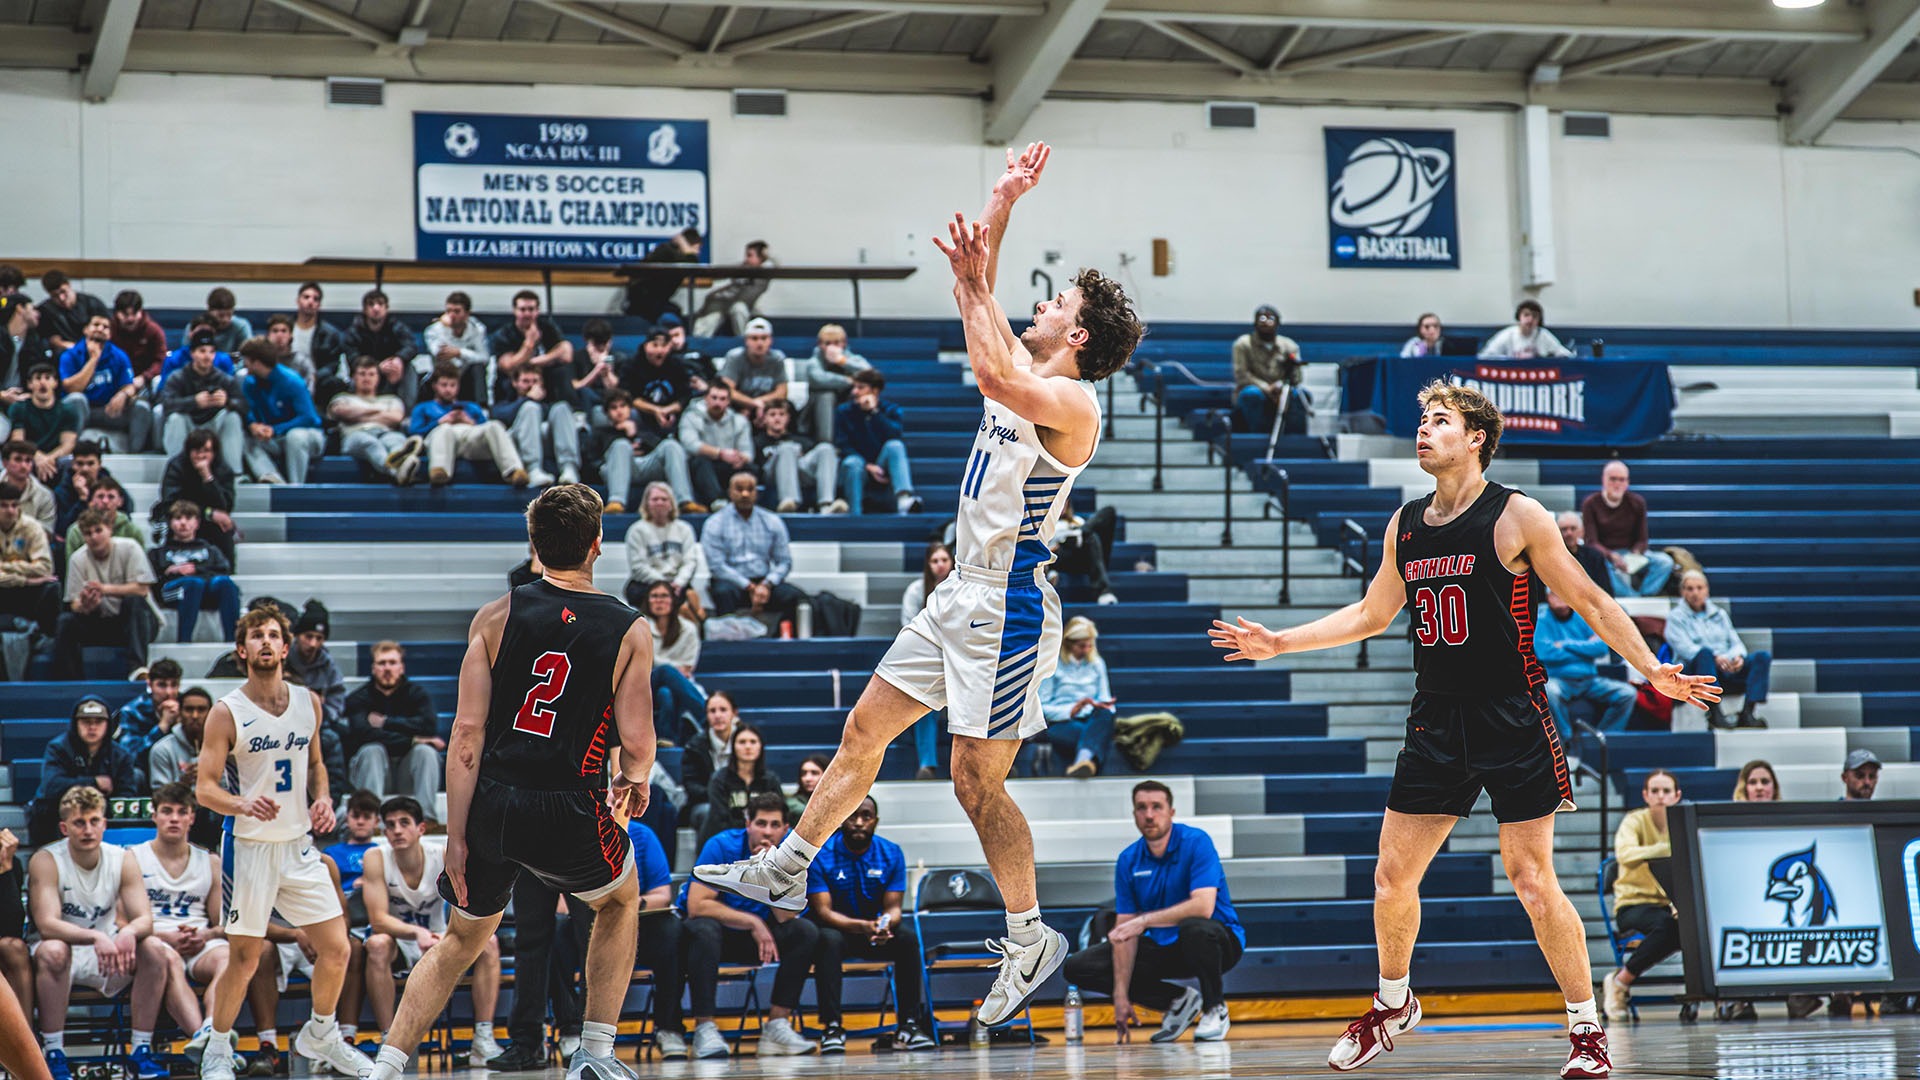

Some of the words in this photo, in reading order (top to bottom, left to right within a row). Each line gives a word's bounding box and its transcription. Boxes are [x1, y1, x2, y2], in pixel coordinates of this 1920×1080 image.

[539, 123, 588, 143] 1989
[505, 144, 556, 160] NCAA
[560, 145, 595, 161] DIV.
[599, 145, 621, 161] III
[484, 174, 549, 192] MEN'S
[556, 175, 645, 194] SOCCER
[426, 197, 552, 225] NATIONAL
[560, 199, 699, 227] CHAMPIONS
[446, 239, 599, 258] ELIZABETHTOWN
[602, 240, 657, 259] COLL
[1357, 235, 1452, 260] BASKETBALL
[989, 415, 1019, 445] Jays
[963, 448, 991, 501] 11
[1405, 554, 1476, 582] CATHOLIC
[1415, 584, 1470, 647] 30
[512, 651, 572, 739] 2
[248, 735, 281, 753] Blue
[285, 732, 310, 751] Jays
[274, 759, 293, 793] 3
[1723, 932, 1803, 967] BLUE
[1806, 939, 1875, 965] JAYS
